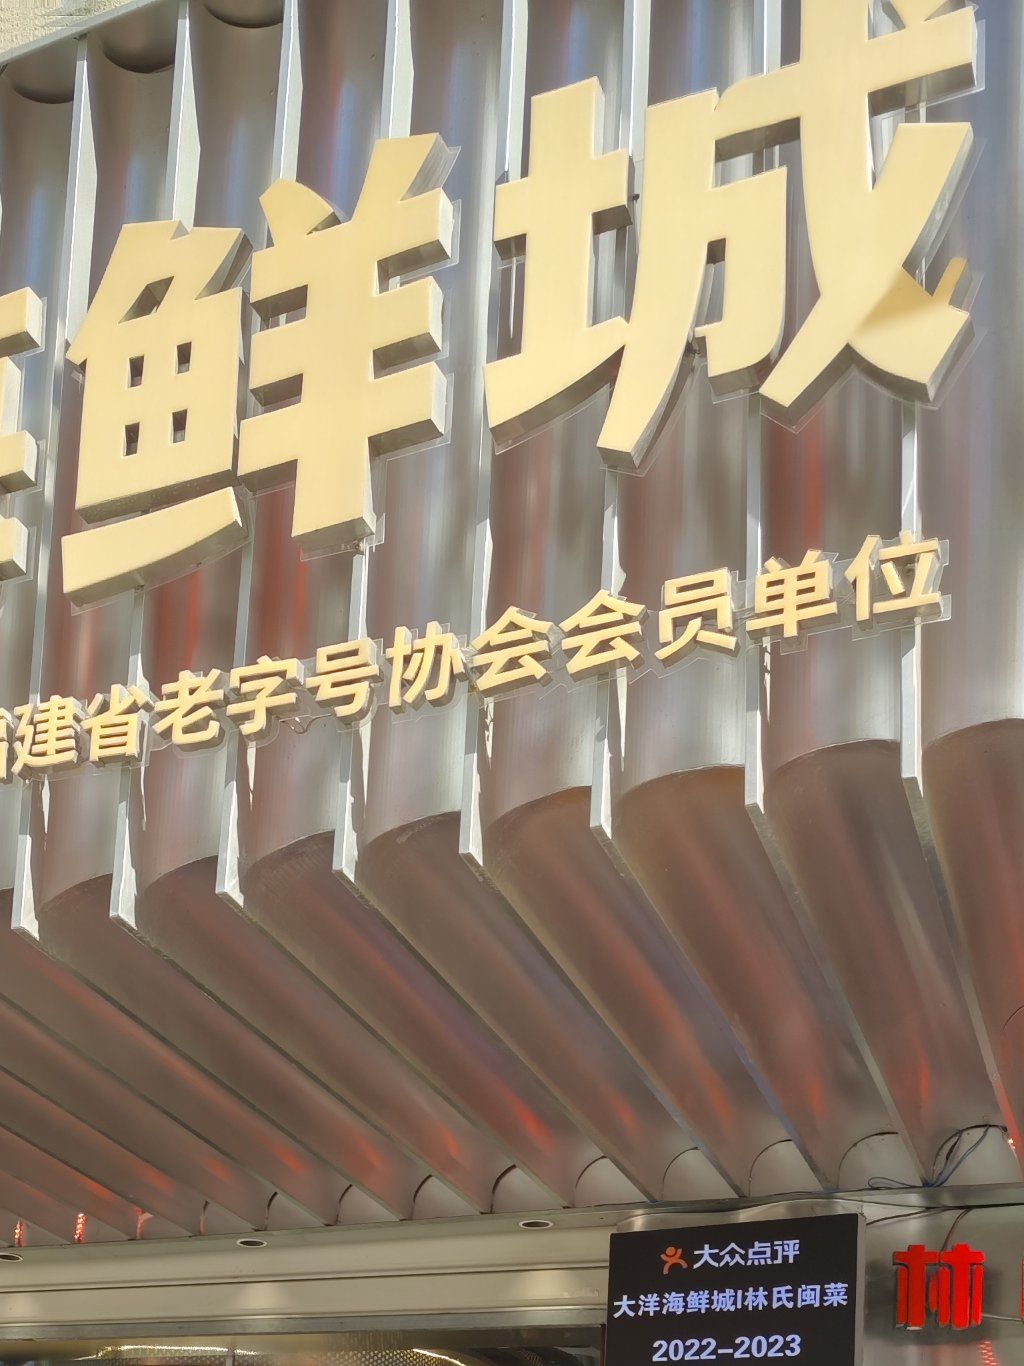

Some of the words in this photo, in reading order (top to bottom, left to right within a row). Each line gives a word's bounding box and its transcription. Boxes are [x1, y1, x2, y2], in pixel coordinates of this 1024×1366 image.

[693, 1239, 800, 1269] 大众点评
[893, 1242, 1024, 1331] 林
[652, 1335, 802, 1362] 2022-2023
